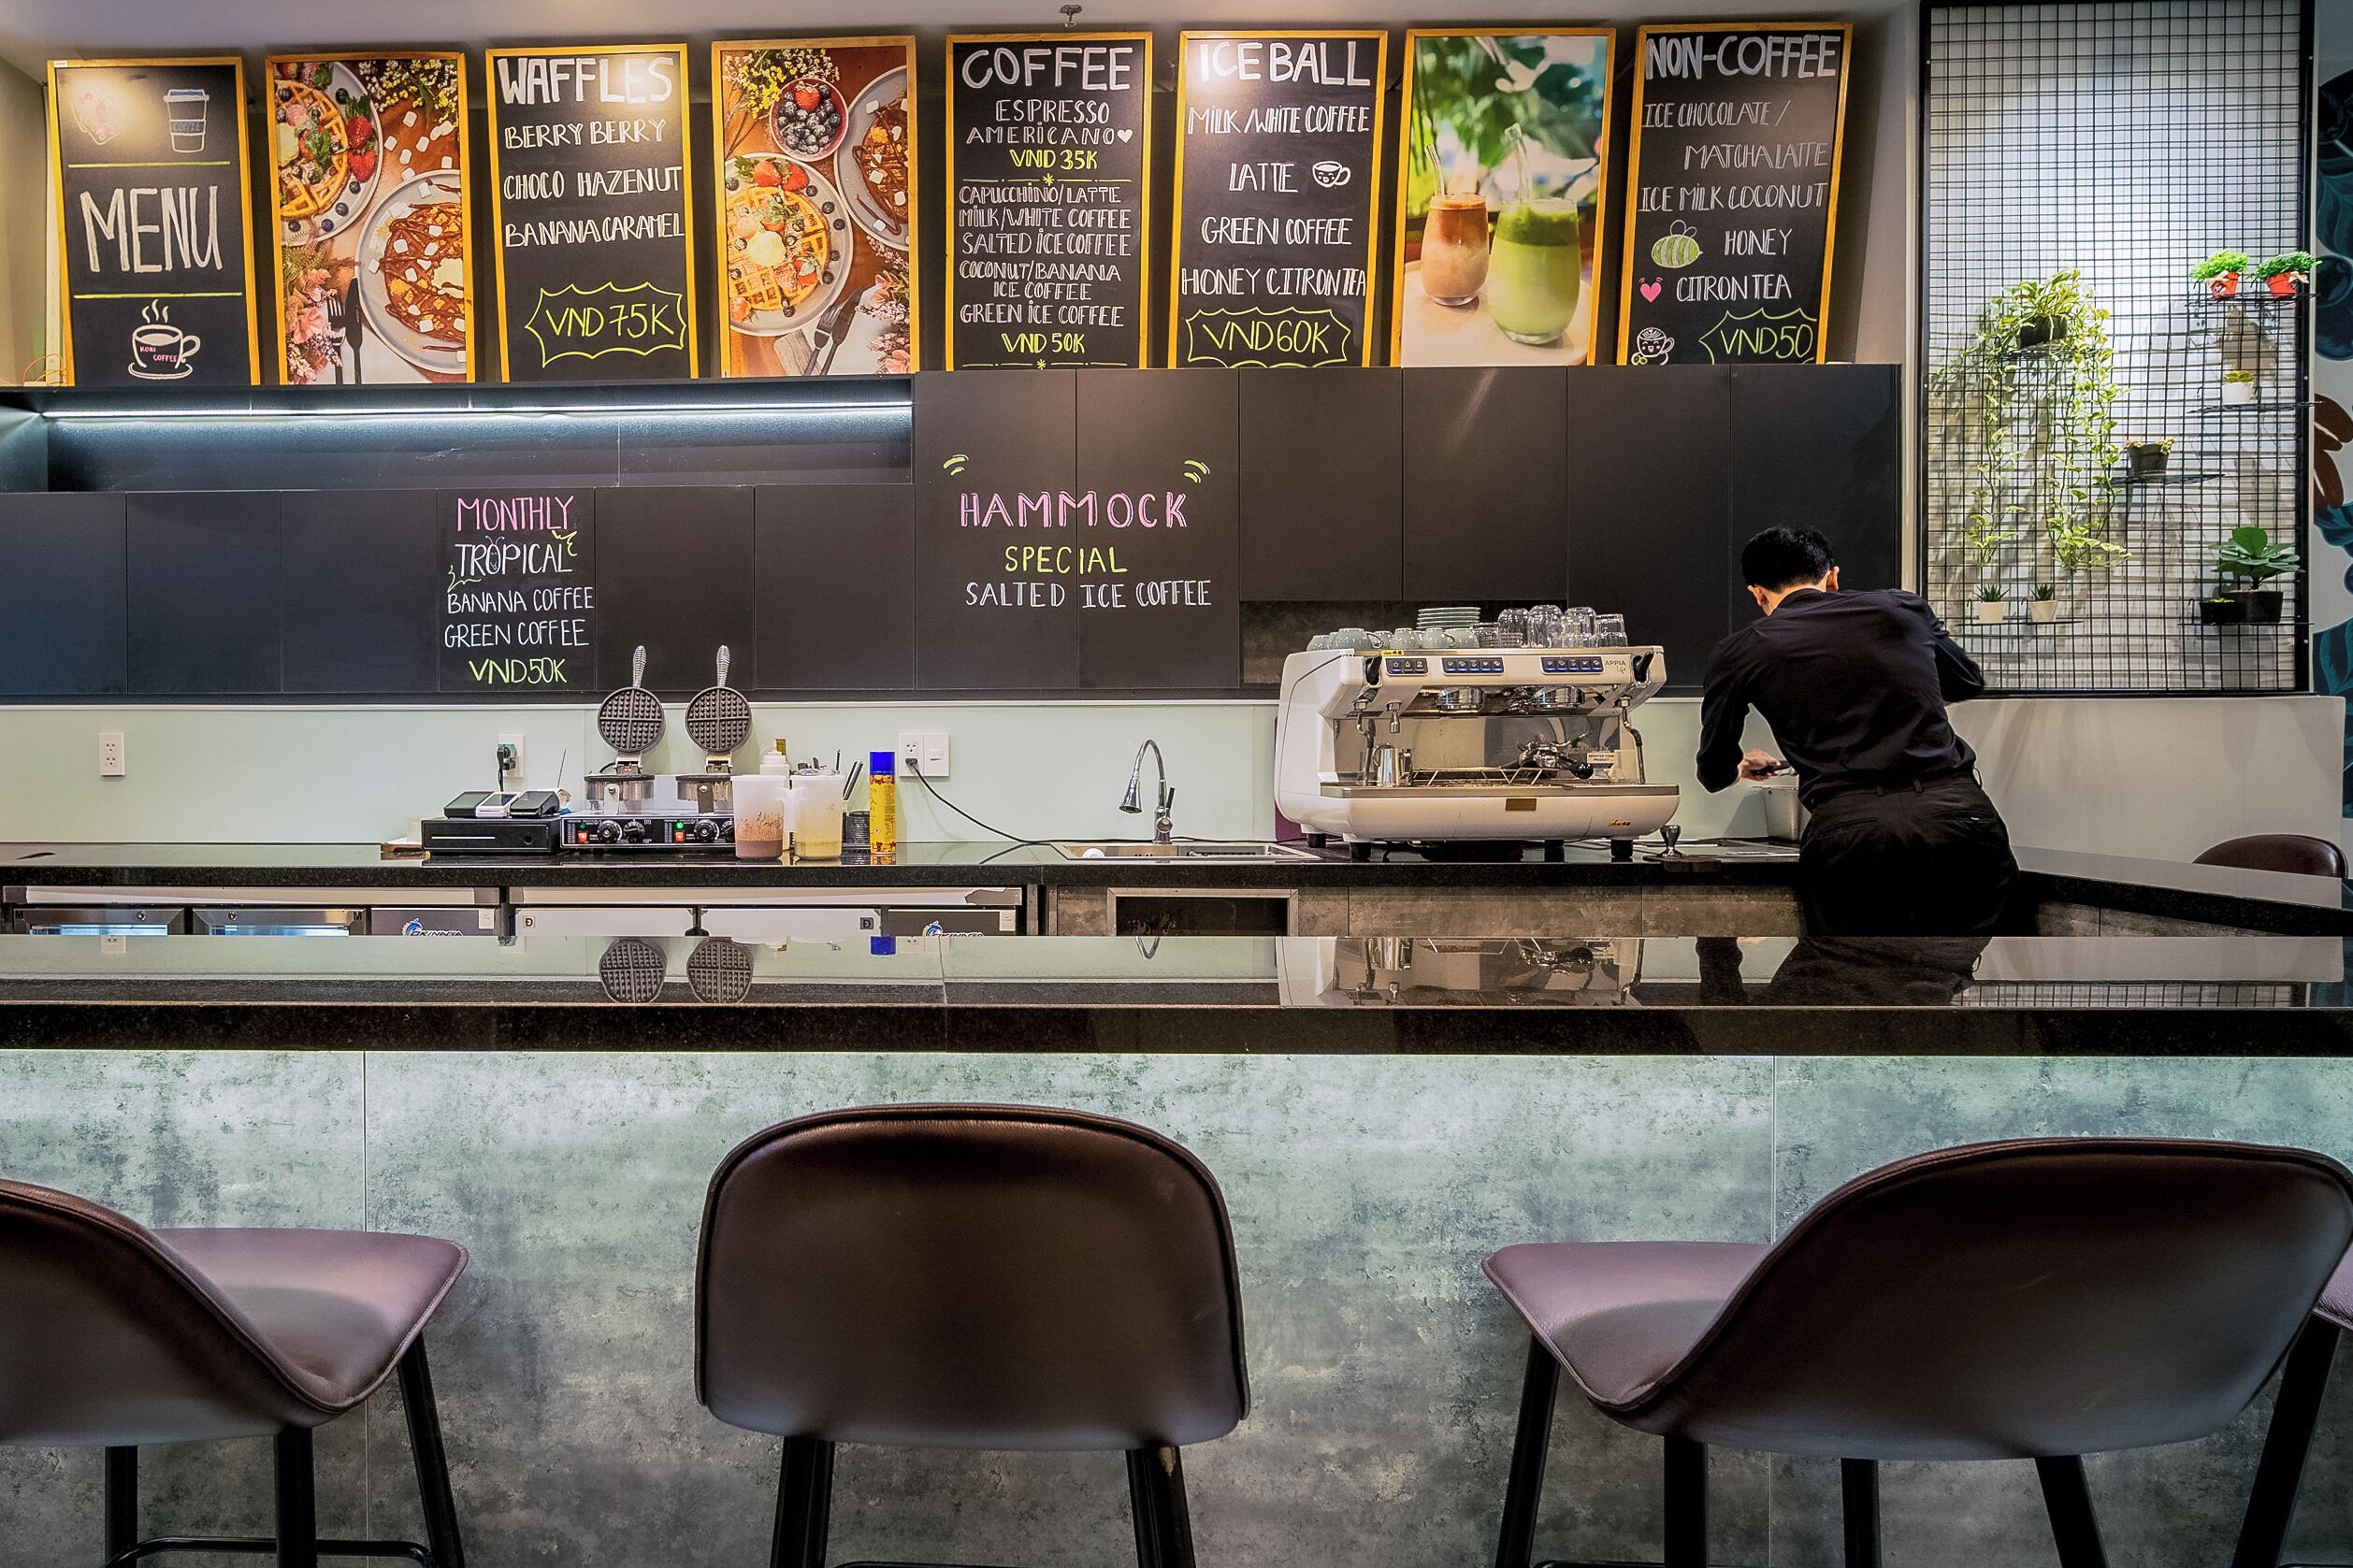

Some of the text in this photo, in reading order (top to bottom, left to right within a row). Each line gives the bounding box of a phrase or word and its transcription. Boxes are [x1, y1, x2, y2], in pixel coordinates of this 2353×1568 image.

[961, 47, 1133, 91] COFFEE
[1199, 41, 1371, 86] ICE BALL
[1645, 34, 1841, 79] NON-COFFEE
[498, 57, 674, 105] WAFFLES
[995, 99, 1110, 123] ESPRESSO
[1305, 105, 1370, 133] COFFEE
[1641, 102, 1675, 128] ICE
[1678, 100, 1773, 126] CHOCOLATE
[504, 119, 666, 149] BERRY BERRY
[966, 122, 1116, 145] AMERICANO
[1009, 149, 1098, 170] VND 35K
[1683, 142, 1829, 170] MATCHA LATTE
[503, 165, 684, 199] CHOCO HAZENUT
[1228, 163, 1299, 193] LATTE
[1638, 182, 1829, 212] ICE MILK COCONUT
[79, 185, 223, 274] MENU
[1067, 209, 1132, 229] COFFEE
[1201, 216, 1353, 245] GREEN COFFEE
[961, 228, 1132, 256] SALTED ICE COFFEE
[1724, 228, 1793, 256] HONEY
[993, 281, 1092, 301] ICE COFFEE
[1181, 267, 1261, 296] HONEY
[1676, 274, 1793, 302] CITRON TEA
[545, 303, 675, 338] VND 75K
[960, 299, 1124, 327] GREEN ICE COFFEE
[1001, 333, 1086, 353] VND 50K
[152, 353, 178, 363] COFFEE
[456, 496, 575, 532] MONTHLY
[960, 491, 1188, 528] HAMMOCK
[454, 541, 574, 577] TROPICAL
[1004, 545, 1129, 575] SPECIAL
[447, 586, 596, 614] BANANA COFFEE
[965, 580, 1212, 609] SALTED ICE COFFEE
[444, 619, 590, 648] GREEN COFFEE
